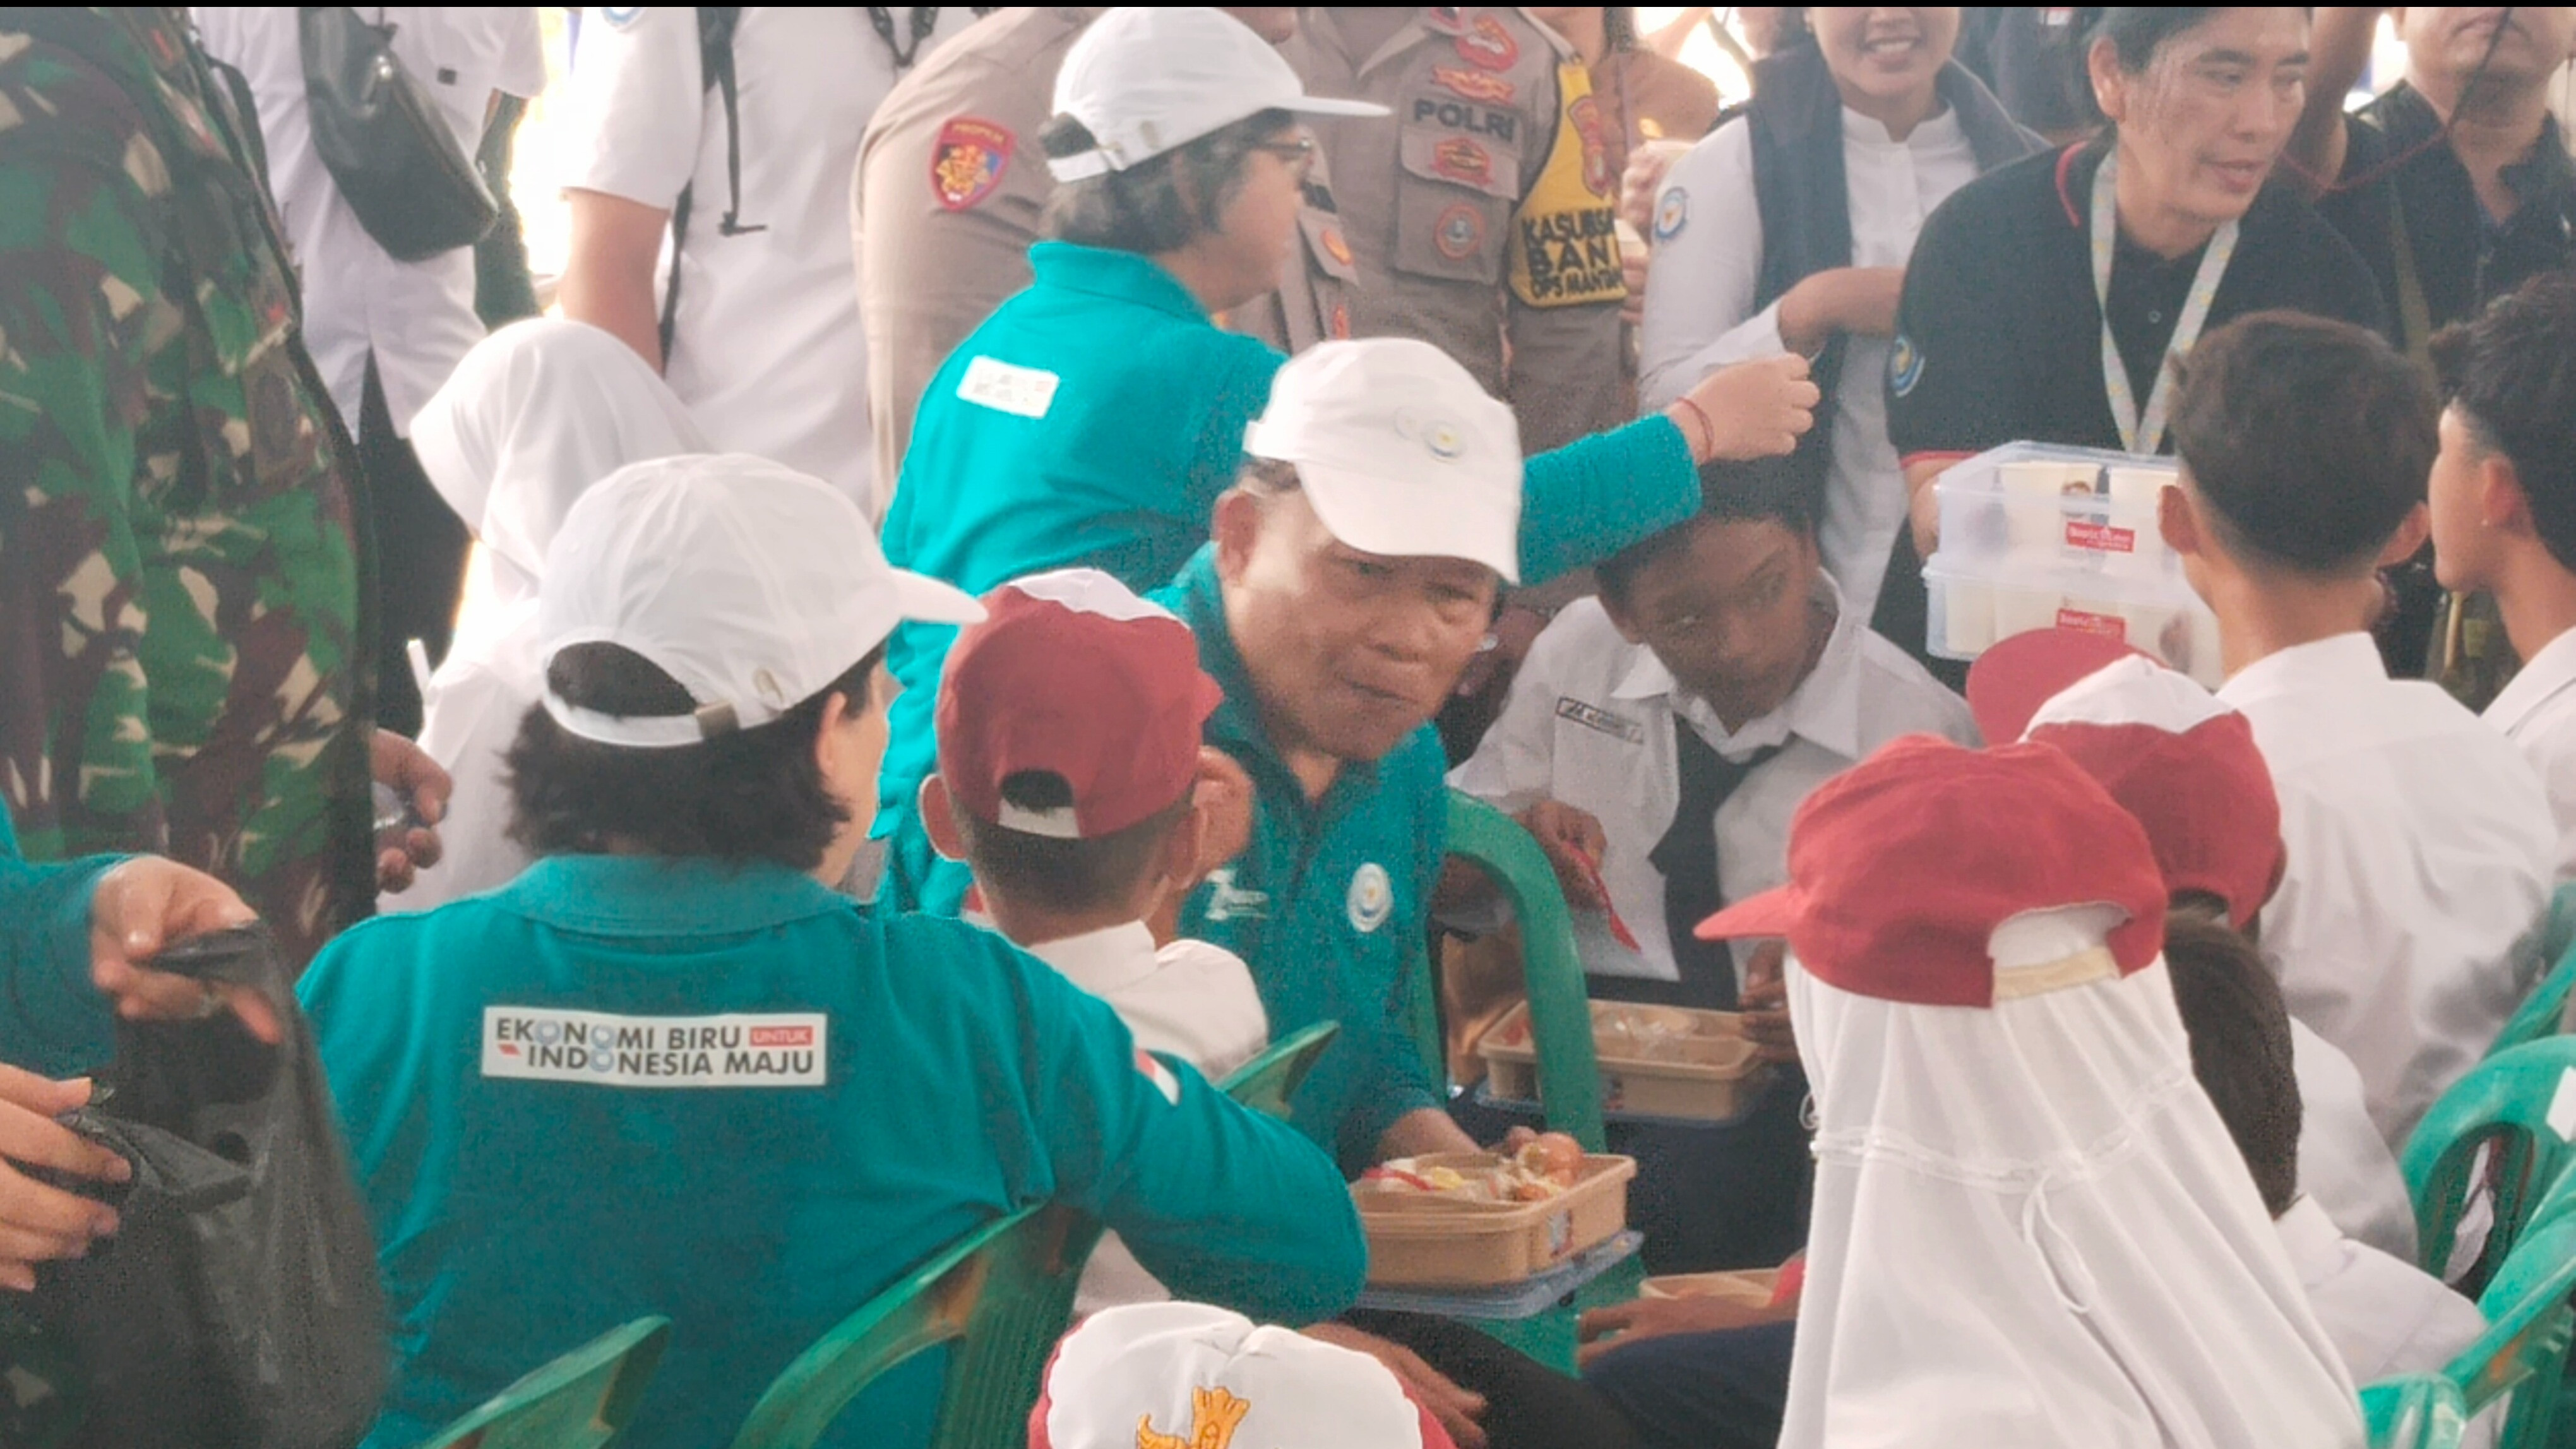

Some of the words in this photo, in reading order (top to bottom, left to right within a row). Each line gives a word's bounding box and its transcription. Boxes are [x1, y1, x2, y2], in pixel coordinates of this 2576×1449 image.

[1413, 98, 1513, 141] POLRI
[496, 1018, 654, 1050] EKONOMI
[667, 1026, 741, 1050] BIRU
[751, 1029, 809, 1045] UNTUK
[528, 1044, 713, 1075] INDONESIA
[724, 1050, 814, 1074] MAJU
